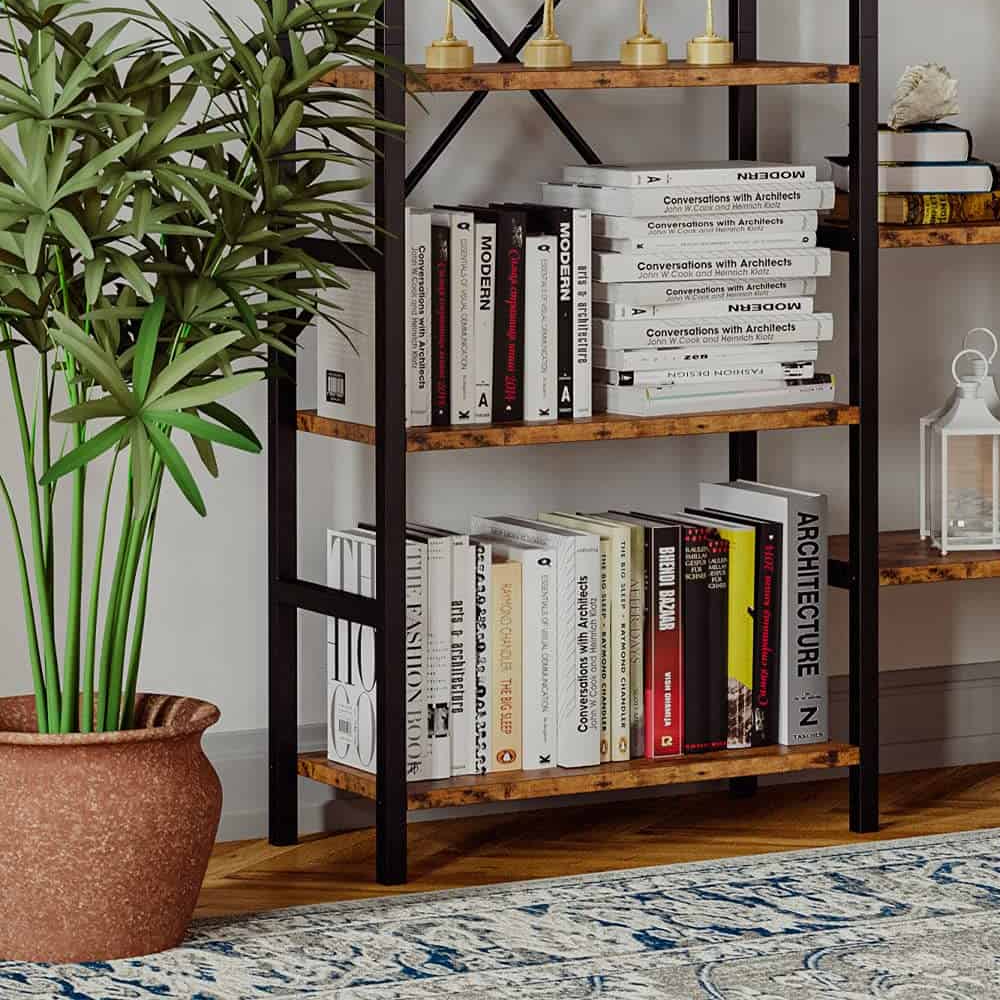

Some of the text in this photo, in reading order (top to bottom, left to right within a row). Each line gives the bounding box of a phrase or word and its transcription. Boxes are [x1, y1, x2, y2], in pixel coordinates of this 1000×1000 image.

[738, 171, 805, 181] MODERN
[664, 192, 800, 205] Conversations with Architects
[648, 221, 713, 229] Conversations
[560, 222, 570, 301] MODERN
[637, 258, 792, 271] Conversations with Architects
[480, 236, 492, 310] MODERN
[577, 266, 588, 285] arts
[715, 268, 748, 276] Heinrich
[666, 287, 724, 296] Conversations
[747, 282, 786, 291] Architects
[728, 302, 801, 312] MODERN
[418, 246, 426, 389] Conversations with Architects
[578, 303, 588, 364] architecture
[646, 323, 795, 337] Conversations with Architects
[721, 334, 753, 342] Heinrich
[478, 393, 488, 408] A
[561, 386, 570, 402] A
[406, 546, 423, 599] THE
[658, 546, 676, 630] BHENDI BAZAAR
[798, 512, 819, 678] ARCHITECTURE
[451, 600, 464, 624] arts
[406, 604, 424, 704] FASHION
[577, 576, 588, 733] Conversations with Architects
[451, 643, 465, 714] architecture
[500, 679, 512, 694] THE
[664, 672, 672, 691] VISH
[500, 696, 512, 711] BIG
[500, 712, 512, 734] SLEEP
